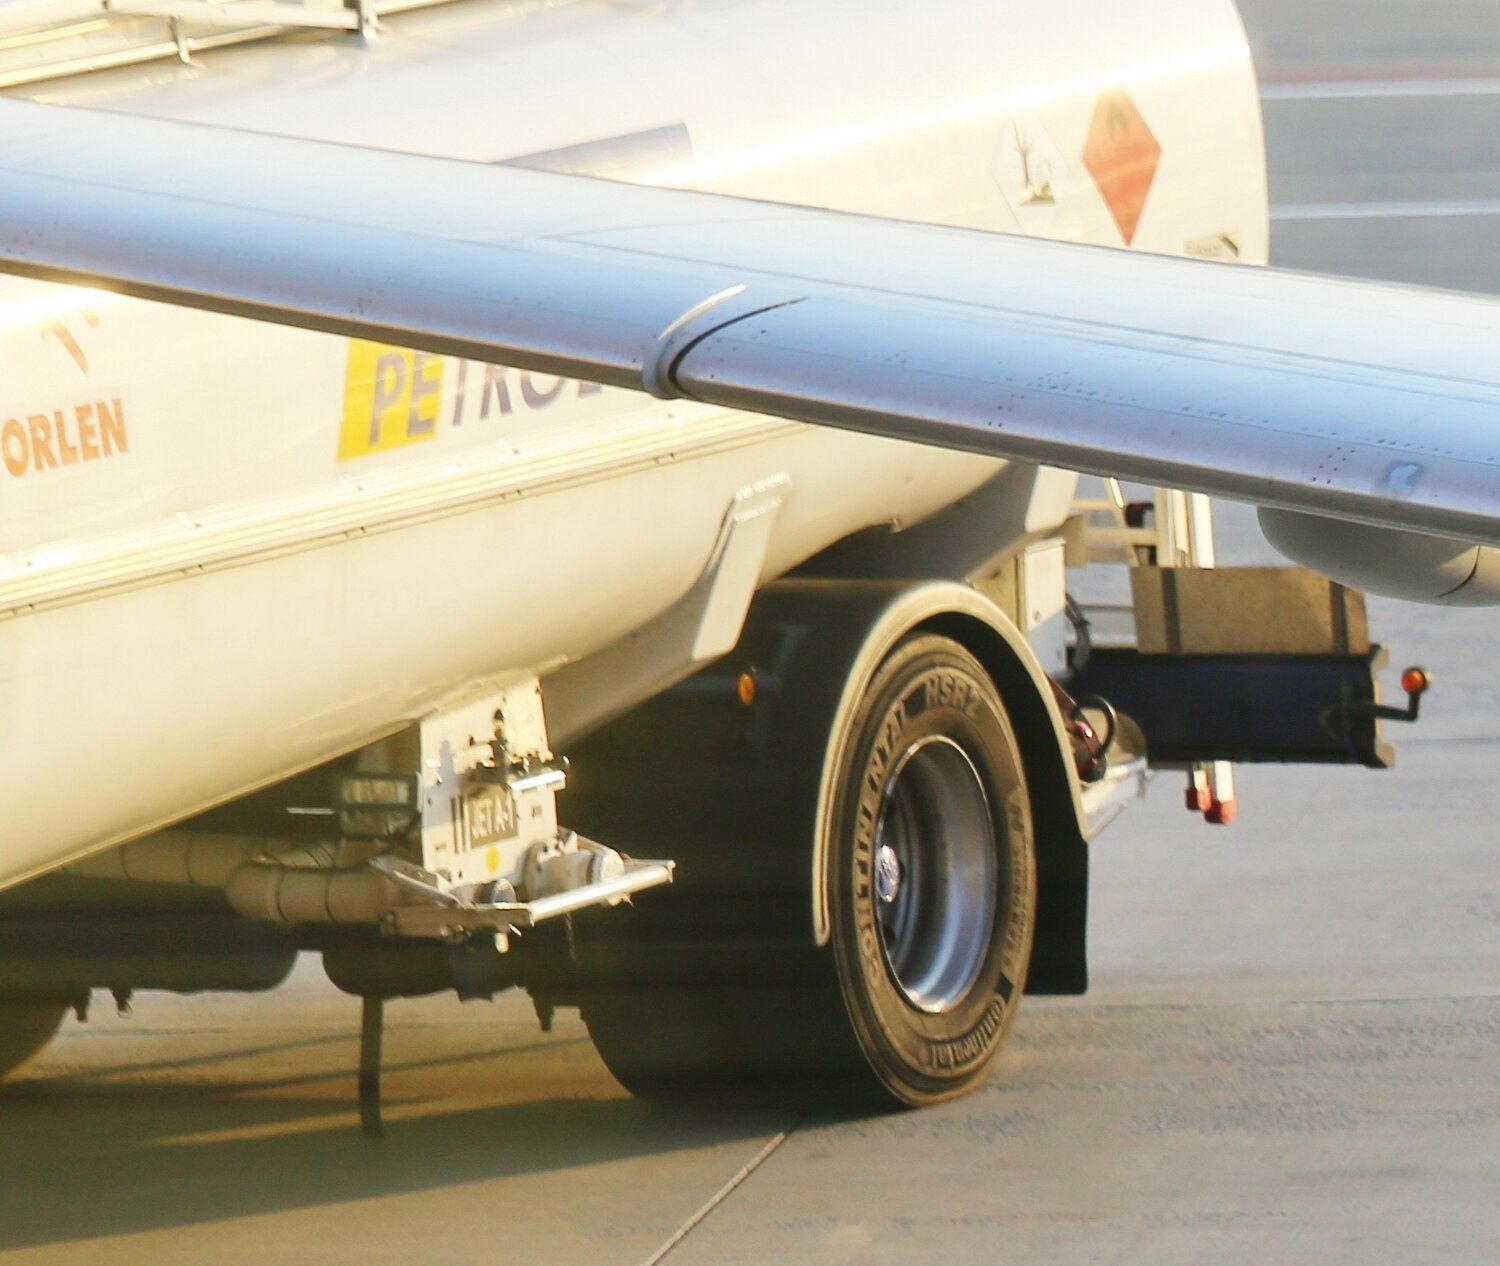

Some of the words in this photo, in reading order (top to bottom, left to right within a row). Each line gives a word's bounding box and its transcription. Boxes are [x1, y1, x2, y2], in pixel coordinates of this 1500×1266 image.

[368, 348, 602, 446] PETRO
[2, 398, 129, 478] ORLEN
[472, 798, 493, 839] JET
